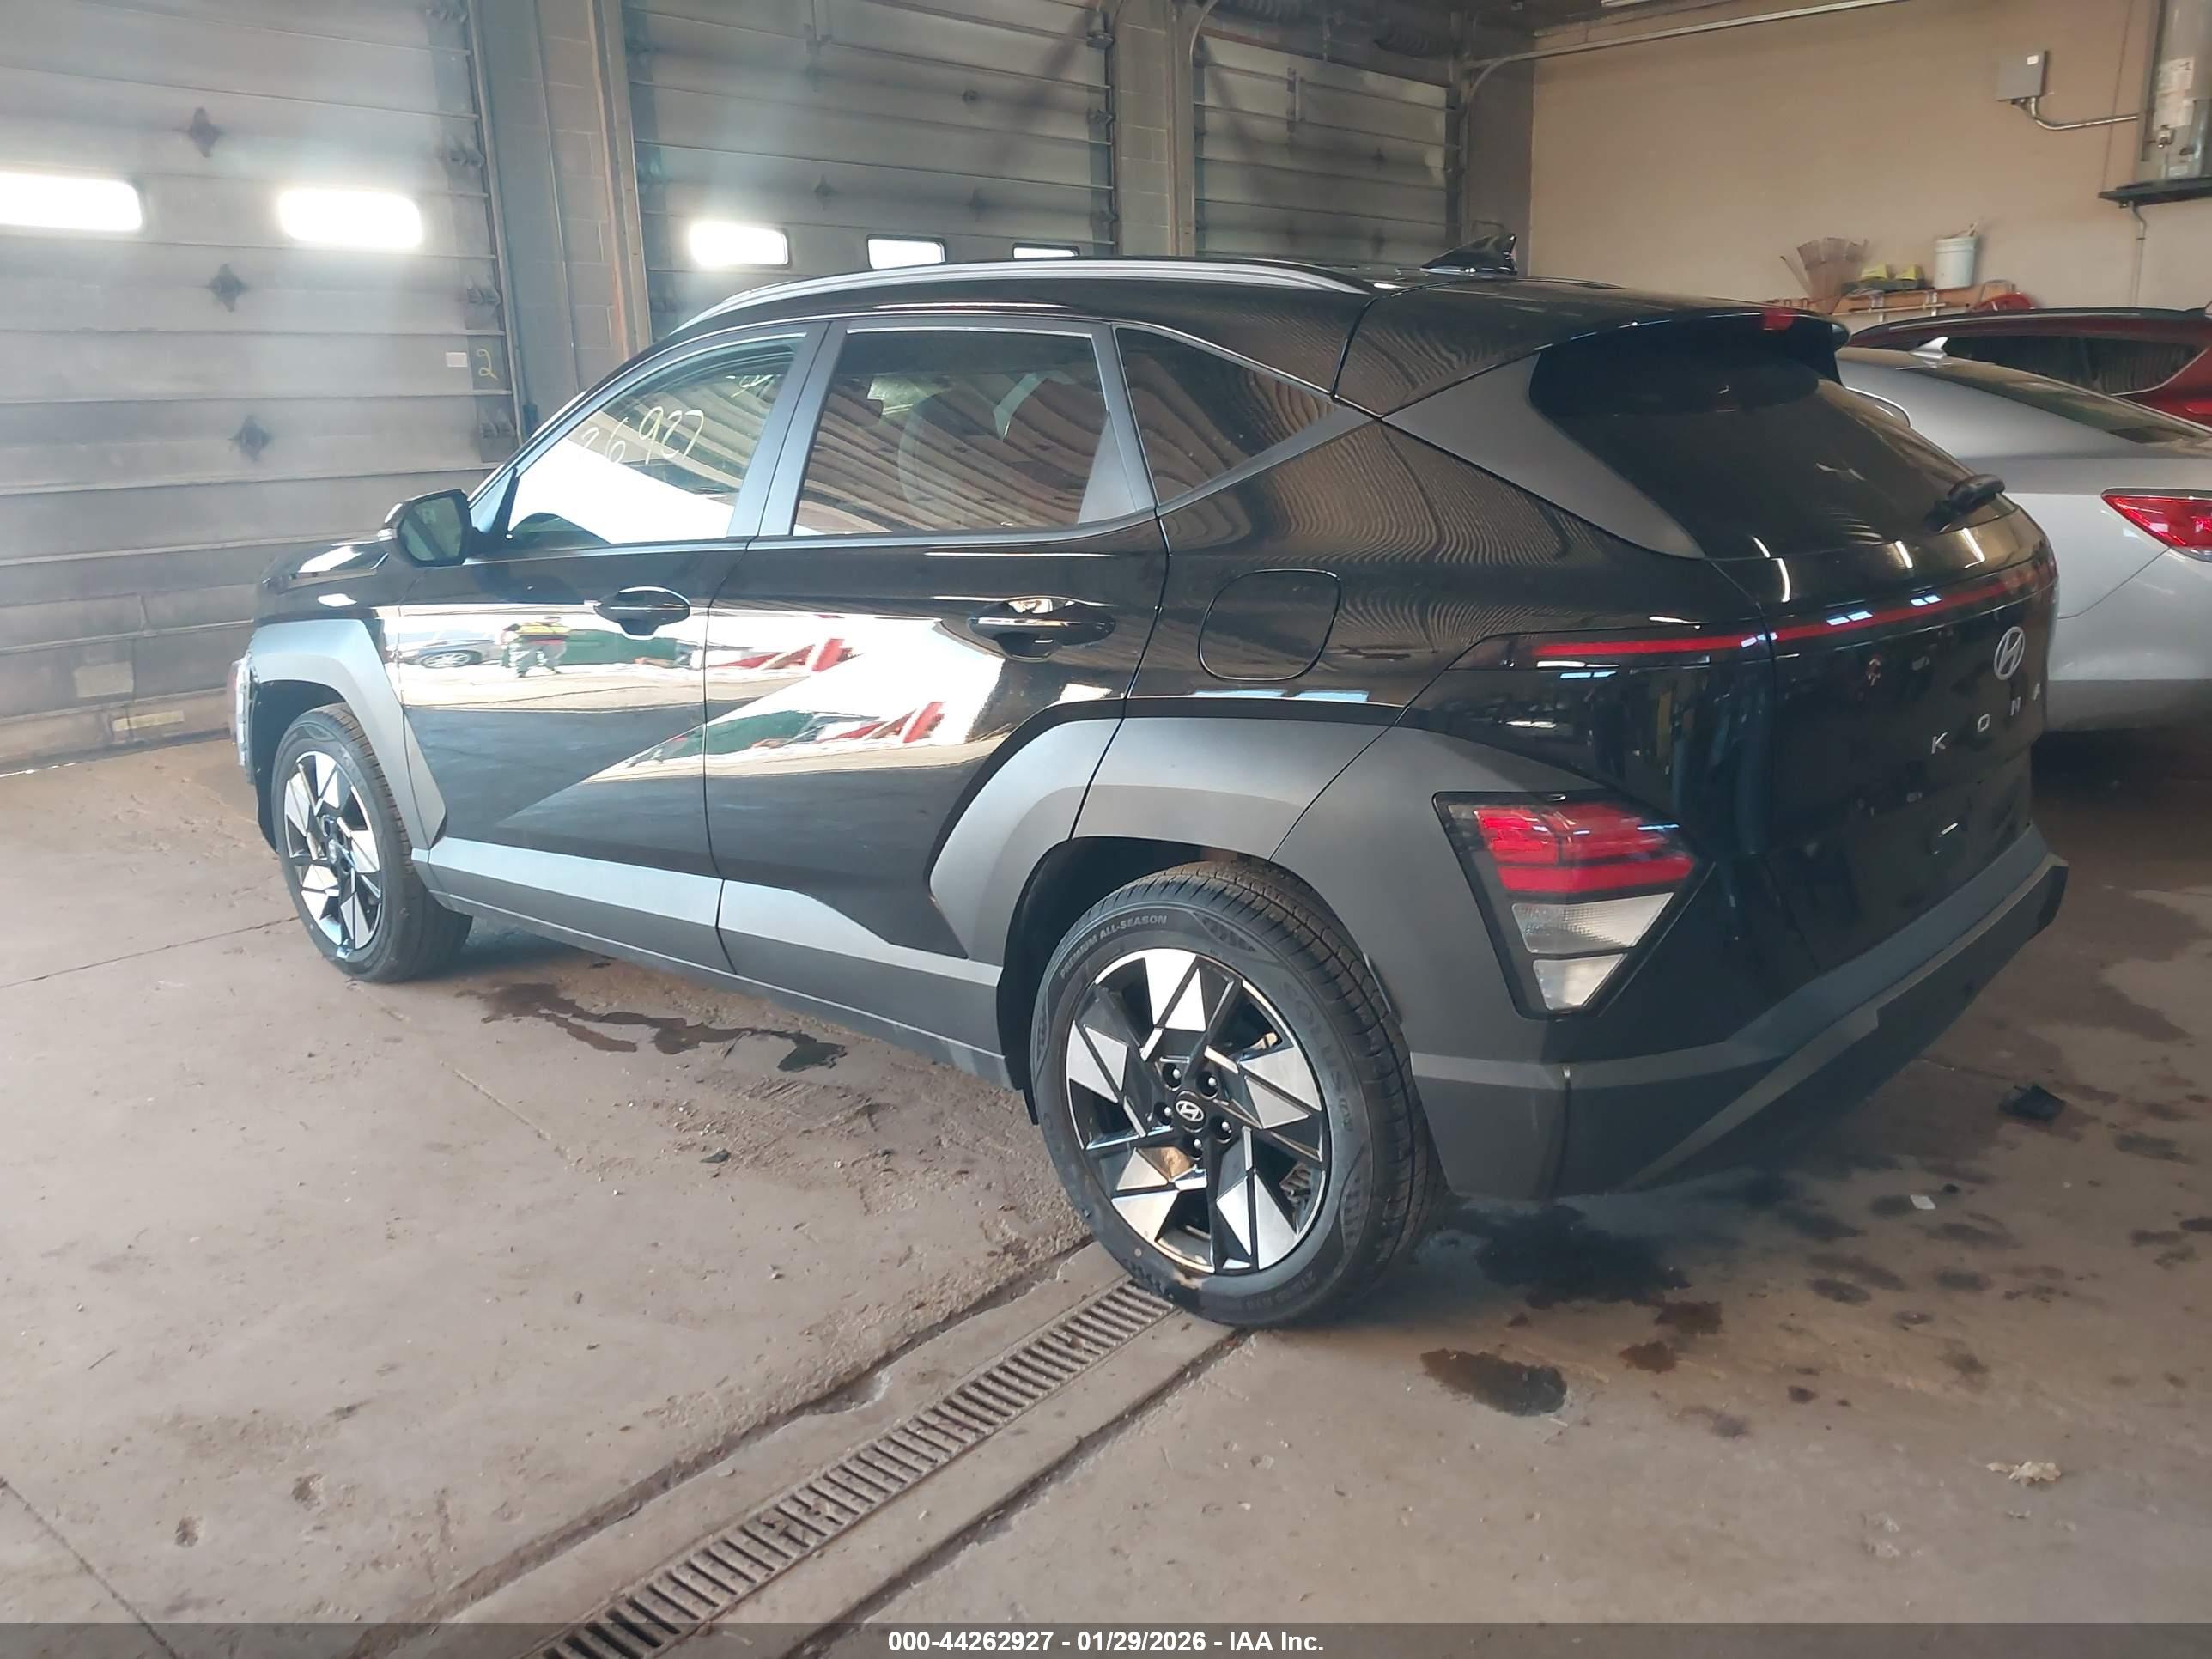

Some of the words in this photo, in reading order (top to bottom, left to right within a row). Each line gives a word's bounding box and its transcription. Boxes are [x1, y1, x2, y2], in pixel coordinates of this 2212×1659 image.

[476, 348, 500, 381] 2
[1060, 933, 1098, 980] PREMIUM
[1099, 915, 1168, 940] ALL-SEASON
